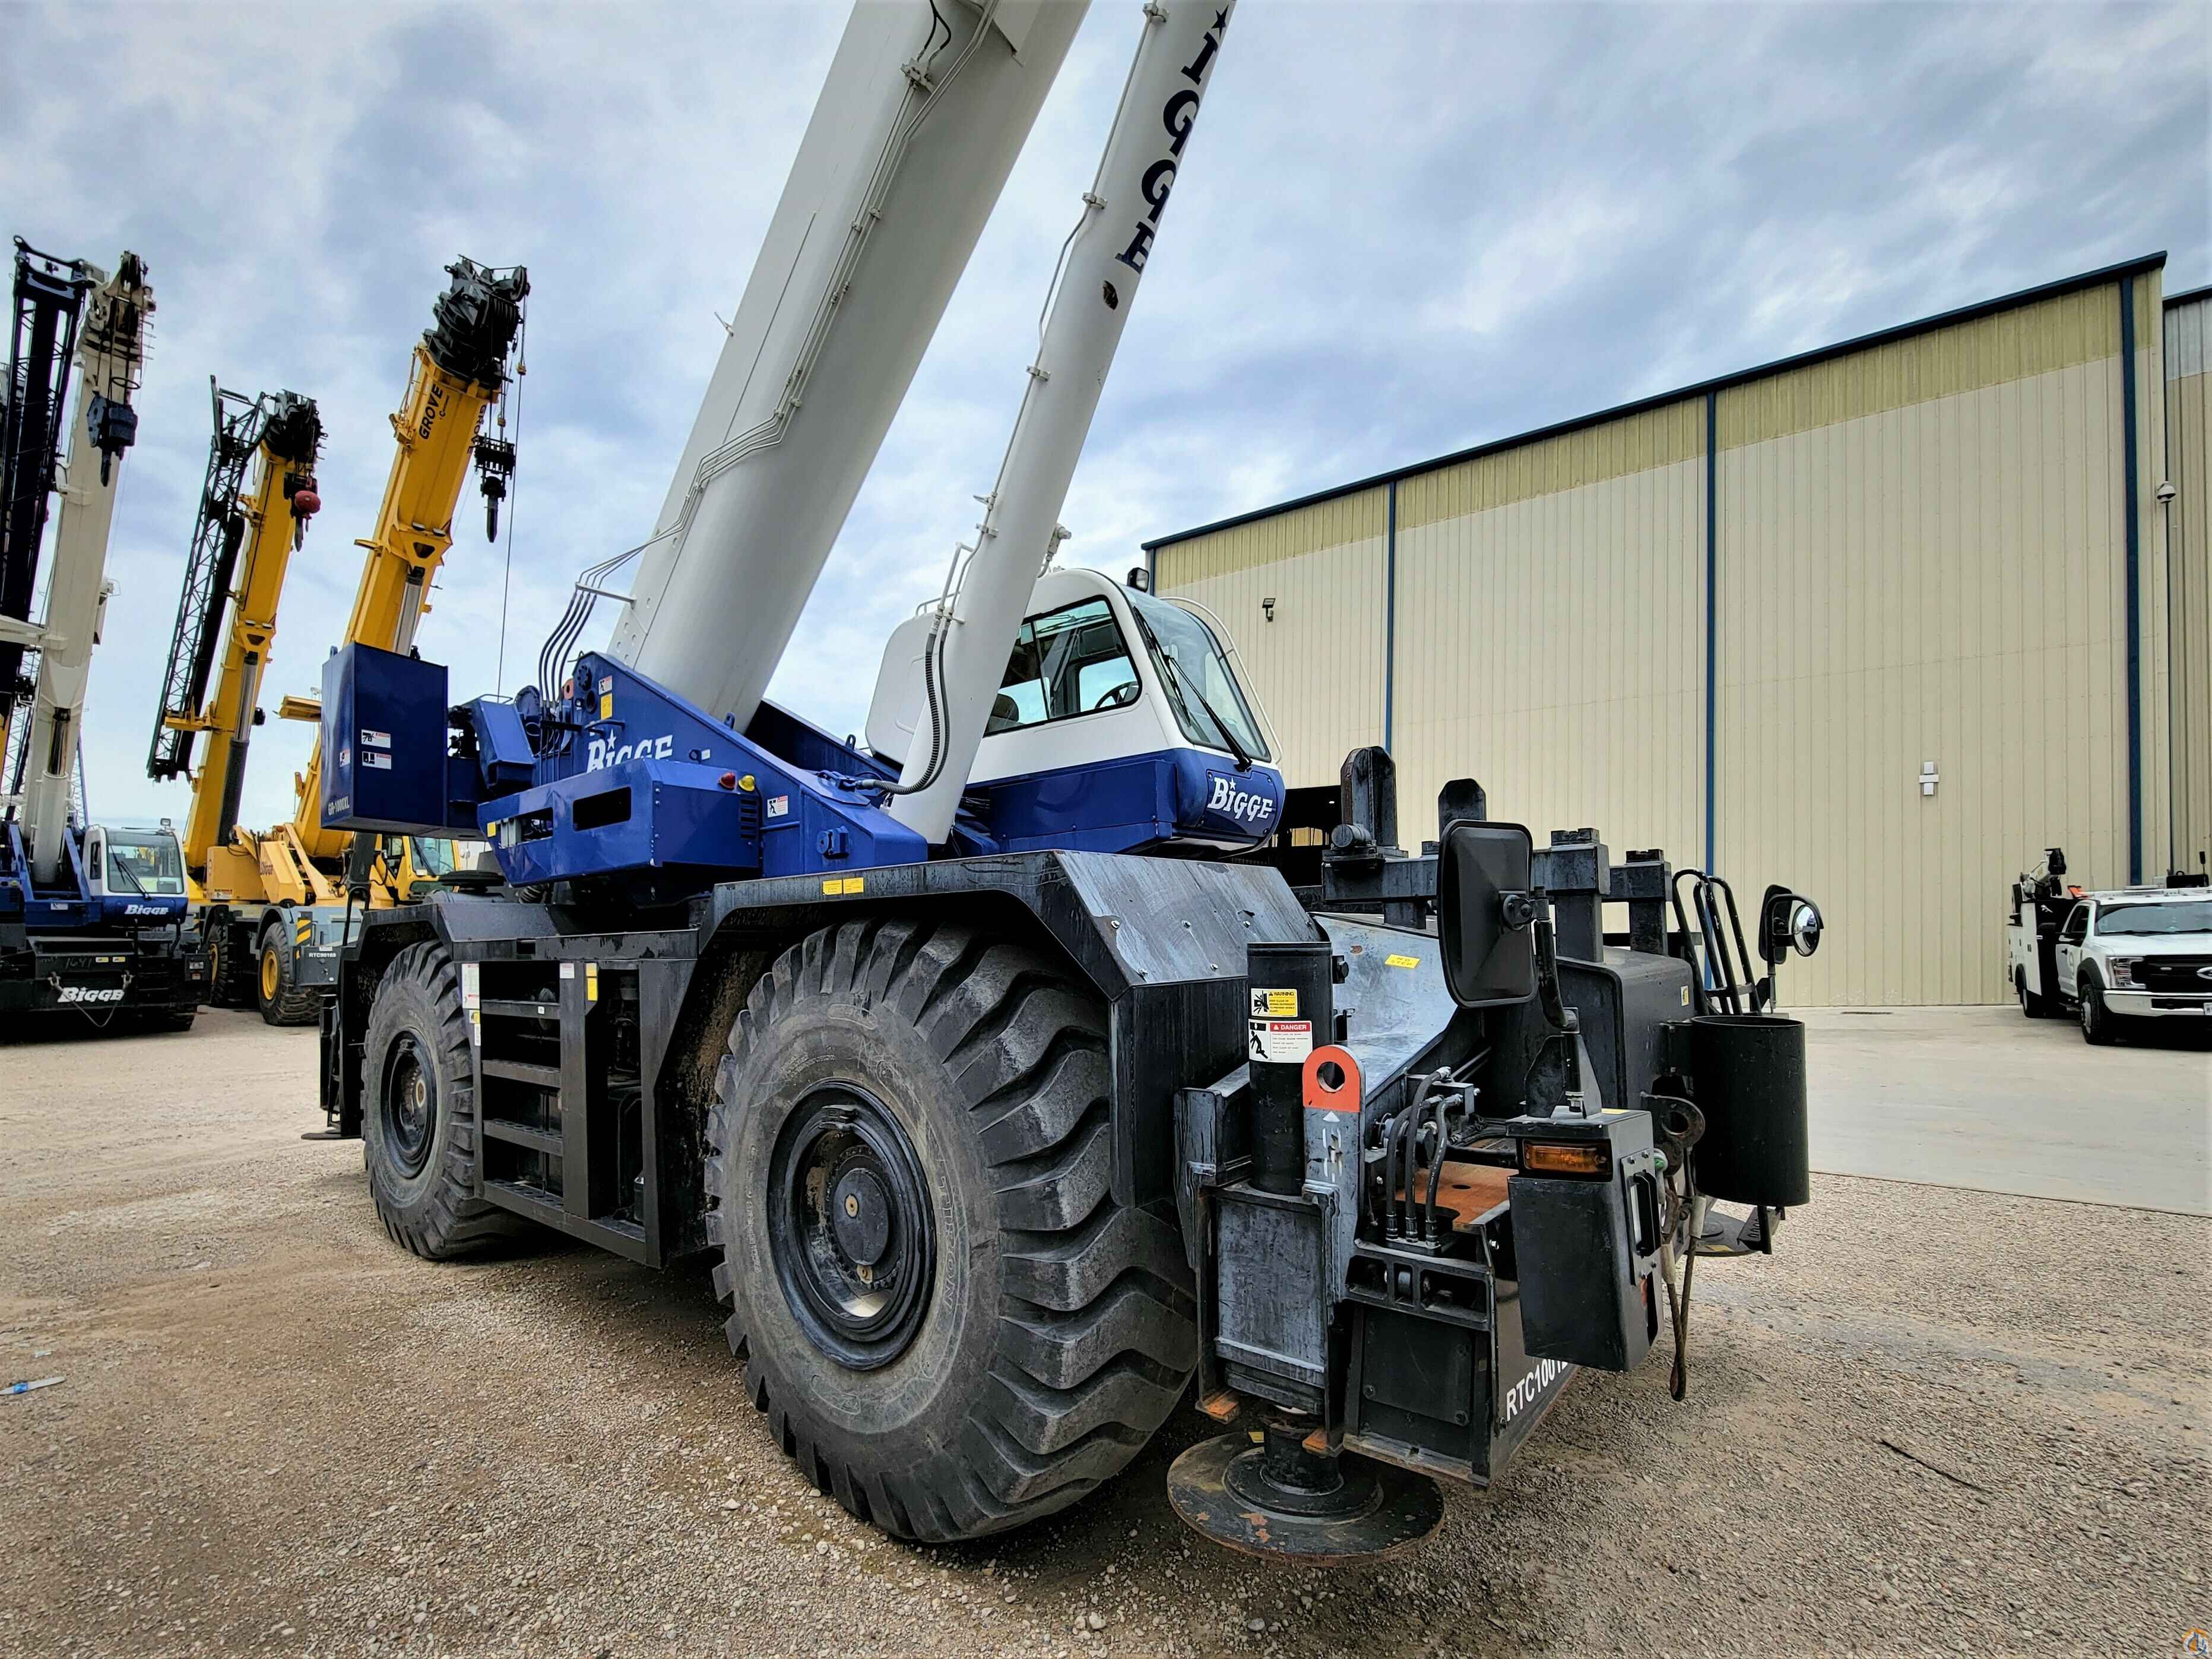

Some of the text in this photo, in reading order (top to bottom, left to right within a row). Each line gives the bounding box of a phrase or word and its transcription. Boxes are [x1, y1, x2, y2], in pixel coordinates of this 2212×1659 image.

[1114, 0, 1234, 275] IGGE
[419, 383, 443, 440] GROVE
[1207, 777, 1273, 822] BIGGE
[124, 904, 169, 915] BIGGE
[57, 986, 125, 1003] BIGGE
[1506, 1358, 1568, 1422] RTC1001
